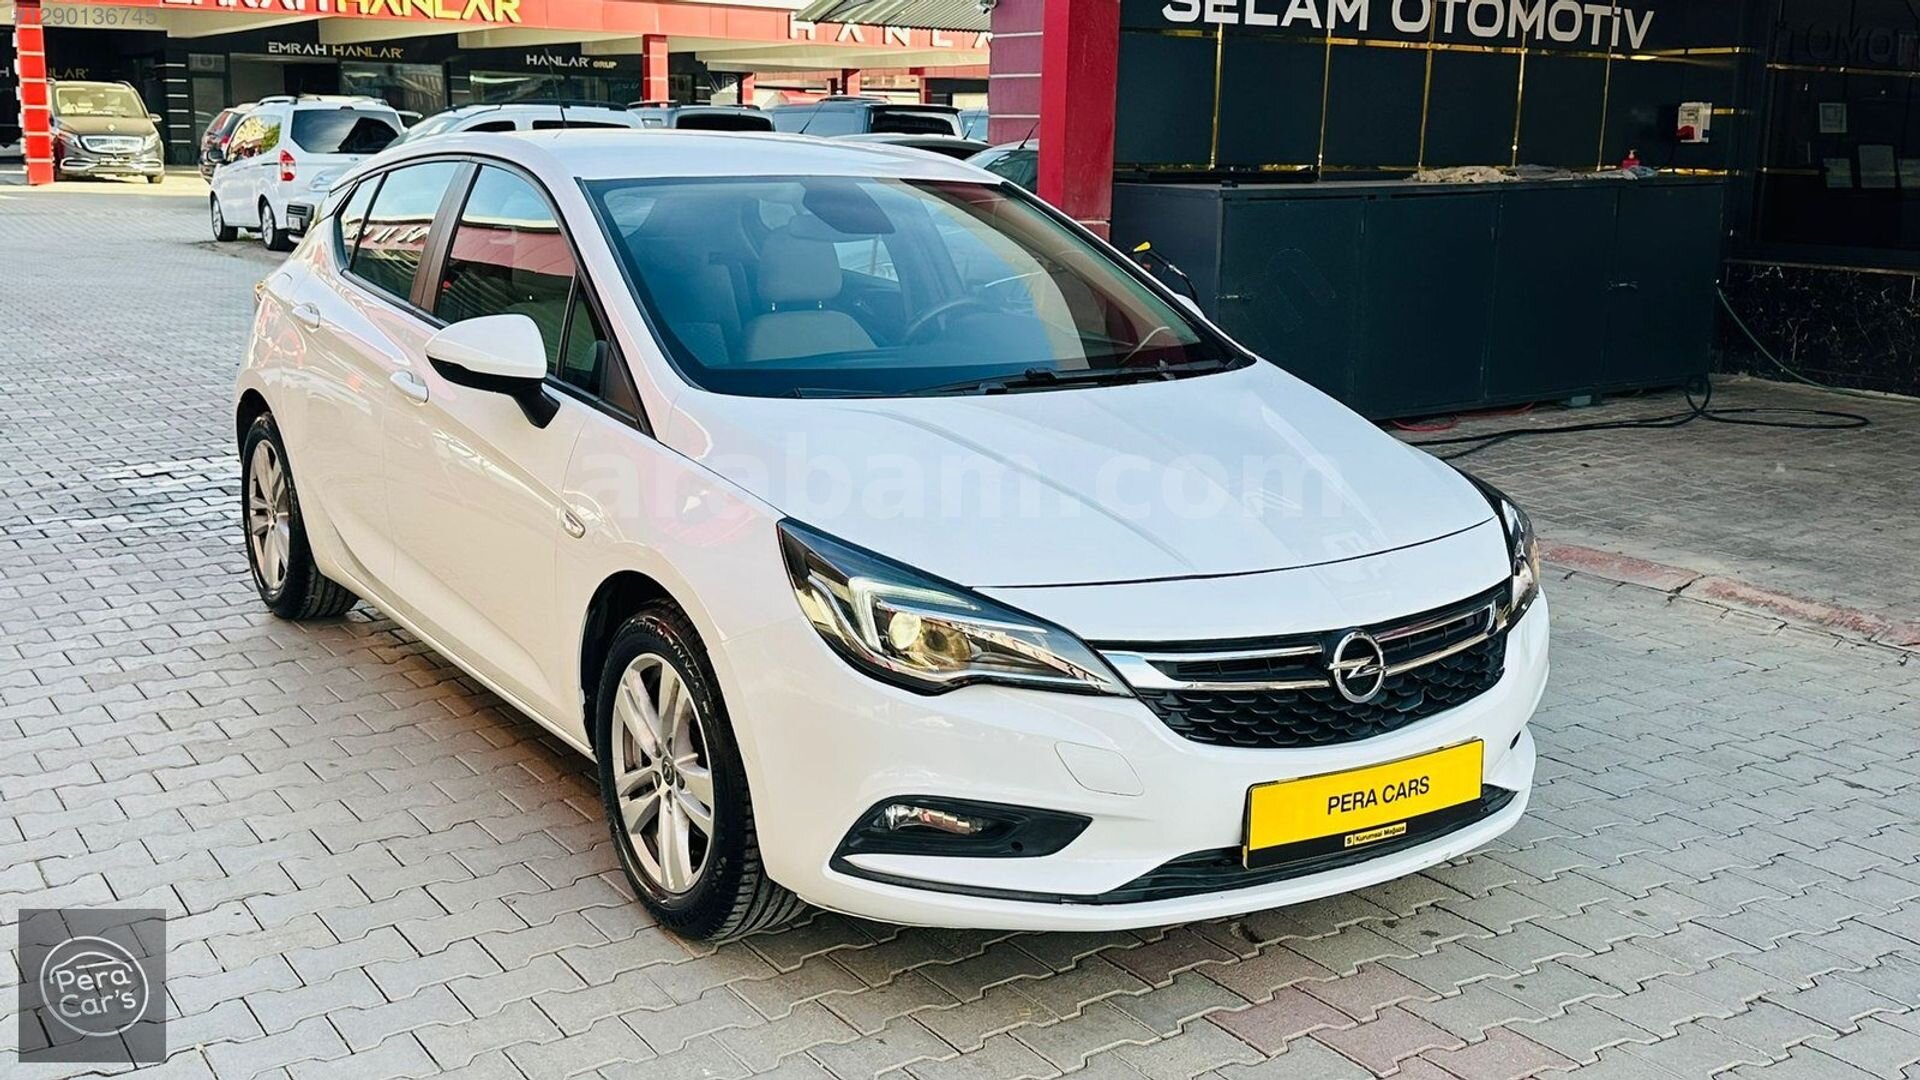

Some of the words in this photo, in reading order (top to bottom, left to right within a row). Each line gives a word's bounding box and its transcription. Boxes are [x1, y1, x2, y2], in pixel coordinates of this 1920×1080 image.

[268, 41, 327, 55] EMRAH
[332, 44, 401, 59] HANLAR
[526, 54, 589, 68] HANLAR
[1327, 788, 1378, 815] PERA
[1382, 775, 1430, 804] CARS
